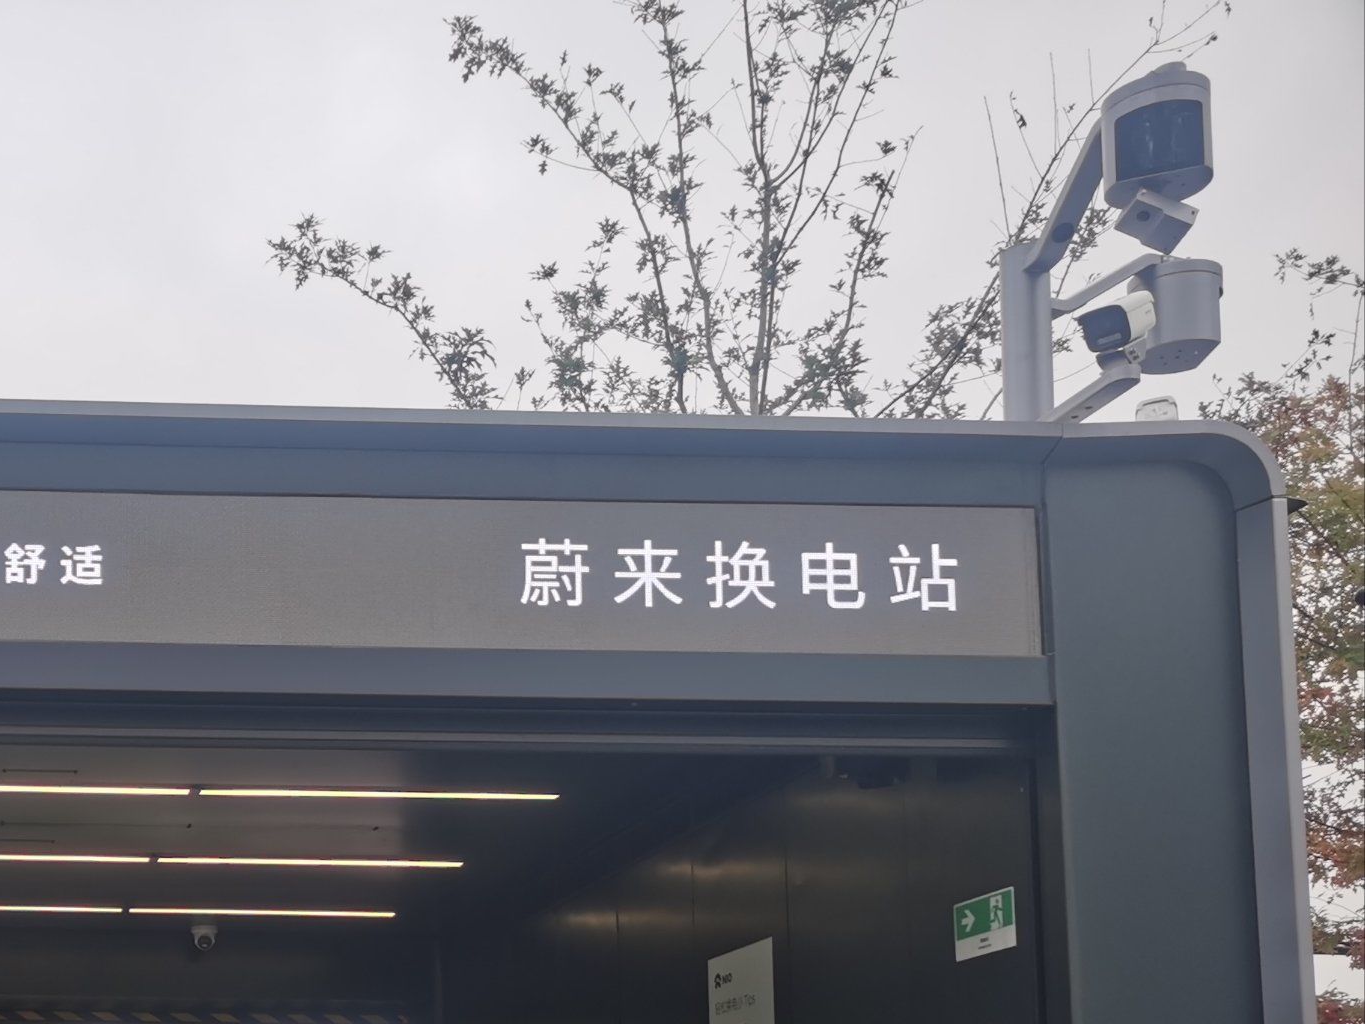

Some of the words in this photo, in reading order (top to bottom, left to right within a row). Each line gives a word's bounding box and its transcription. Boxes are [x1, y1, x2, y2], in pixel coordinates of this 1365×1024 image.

[520, 537, 959, 612] 蔚来换电站
